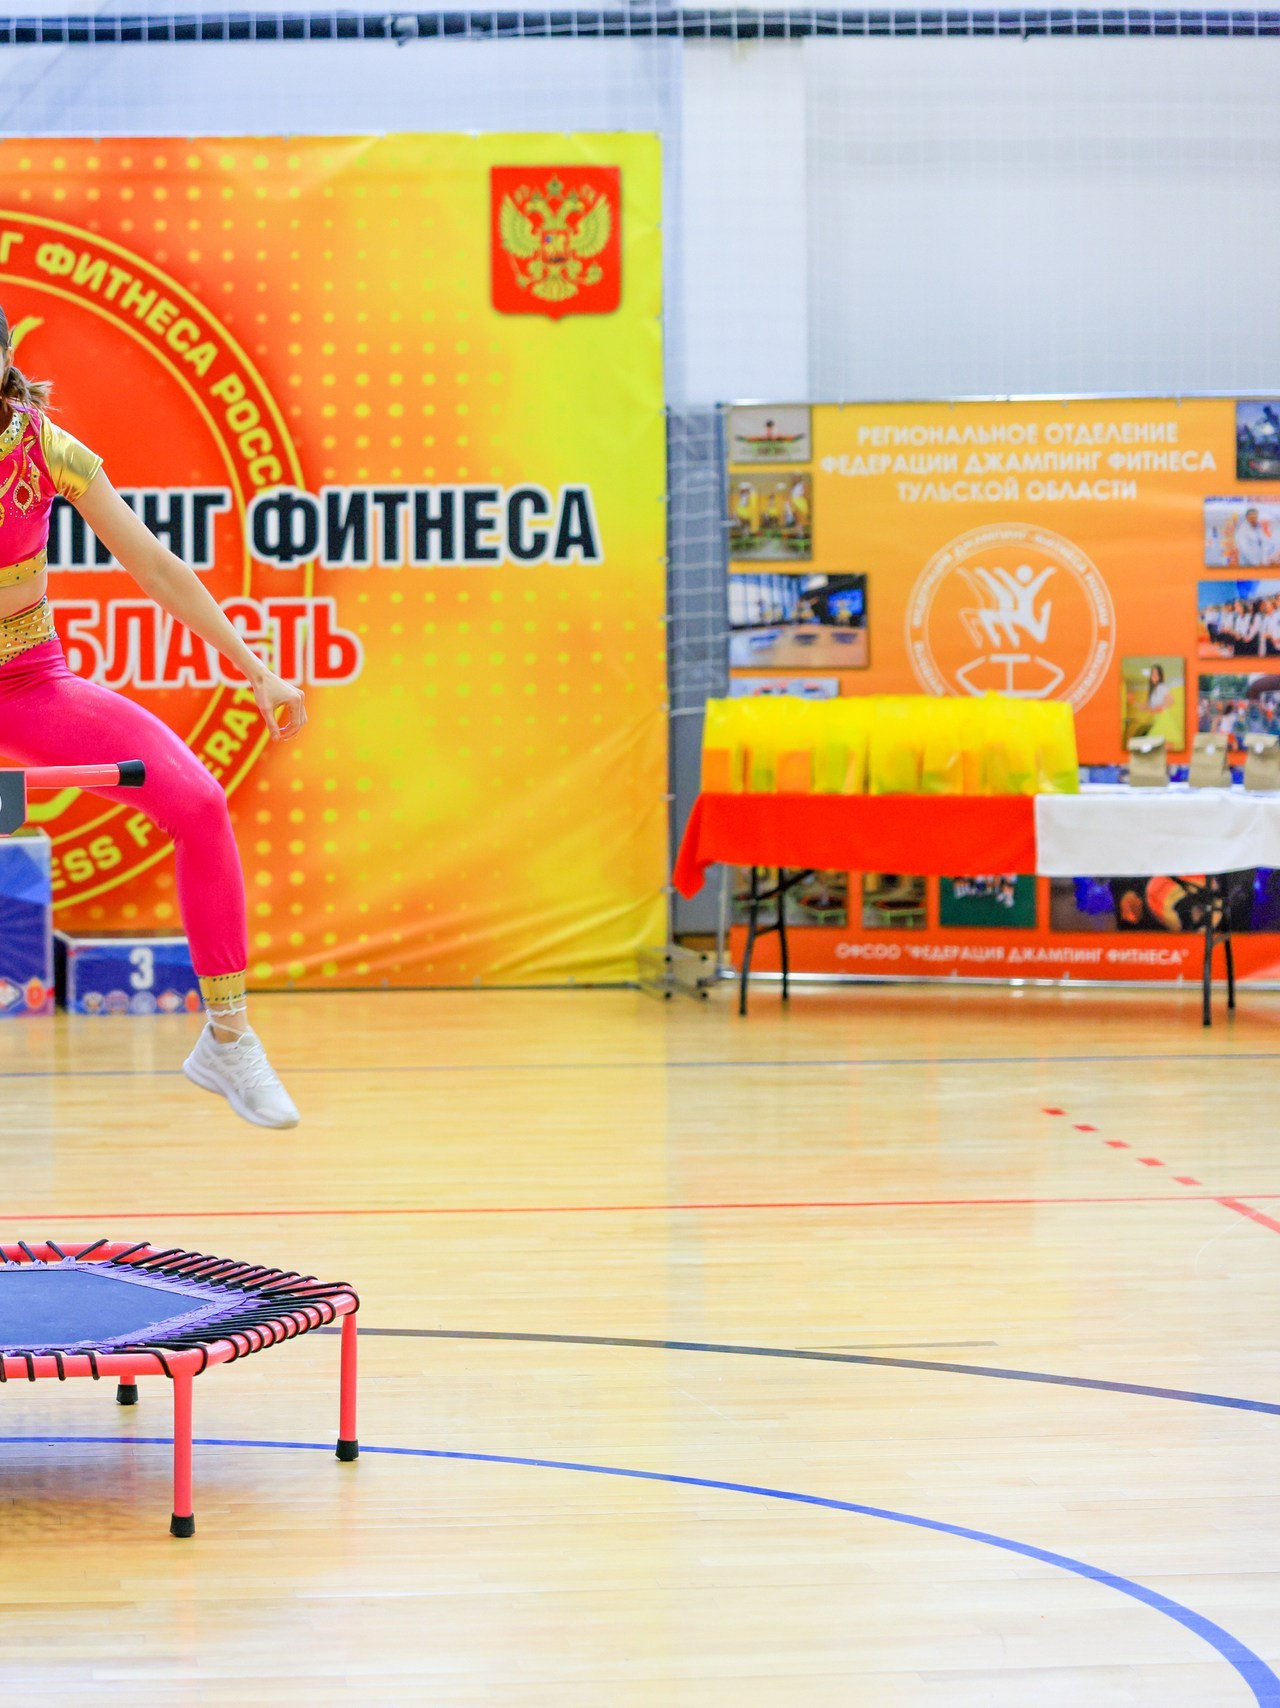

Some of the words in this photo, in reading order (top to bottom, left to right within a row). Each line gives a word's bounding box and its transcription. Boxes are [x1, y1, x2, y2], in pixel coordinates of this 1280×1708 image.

[35, 242, 218, 378] ФИТНЕСА
[210, 371, 286, 495] РОСС
[857, 423, 1038, 447] РЕГИОНАЛЬНОЕ
[1044, 422, 1178, 446] ОТДЕЛЕНИЕ
[964, 451, 1099, 475] ДЖАМПИНГ
[1107, 450, 1217, 473] ФИТНЕСА
[897, 476, 1019, 502] ТУЛЬСКОЙ
[1026, 479, 1137, 502] ОБЛАСТИ
[250, 486, 600, 566] ФИТНЕСА
[52, 599, 358, 688] БЛАСТЬ
[129, 946, 155, 989] 3
